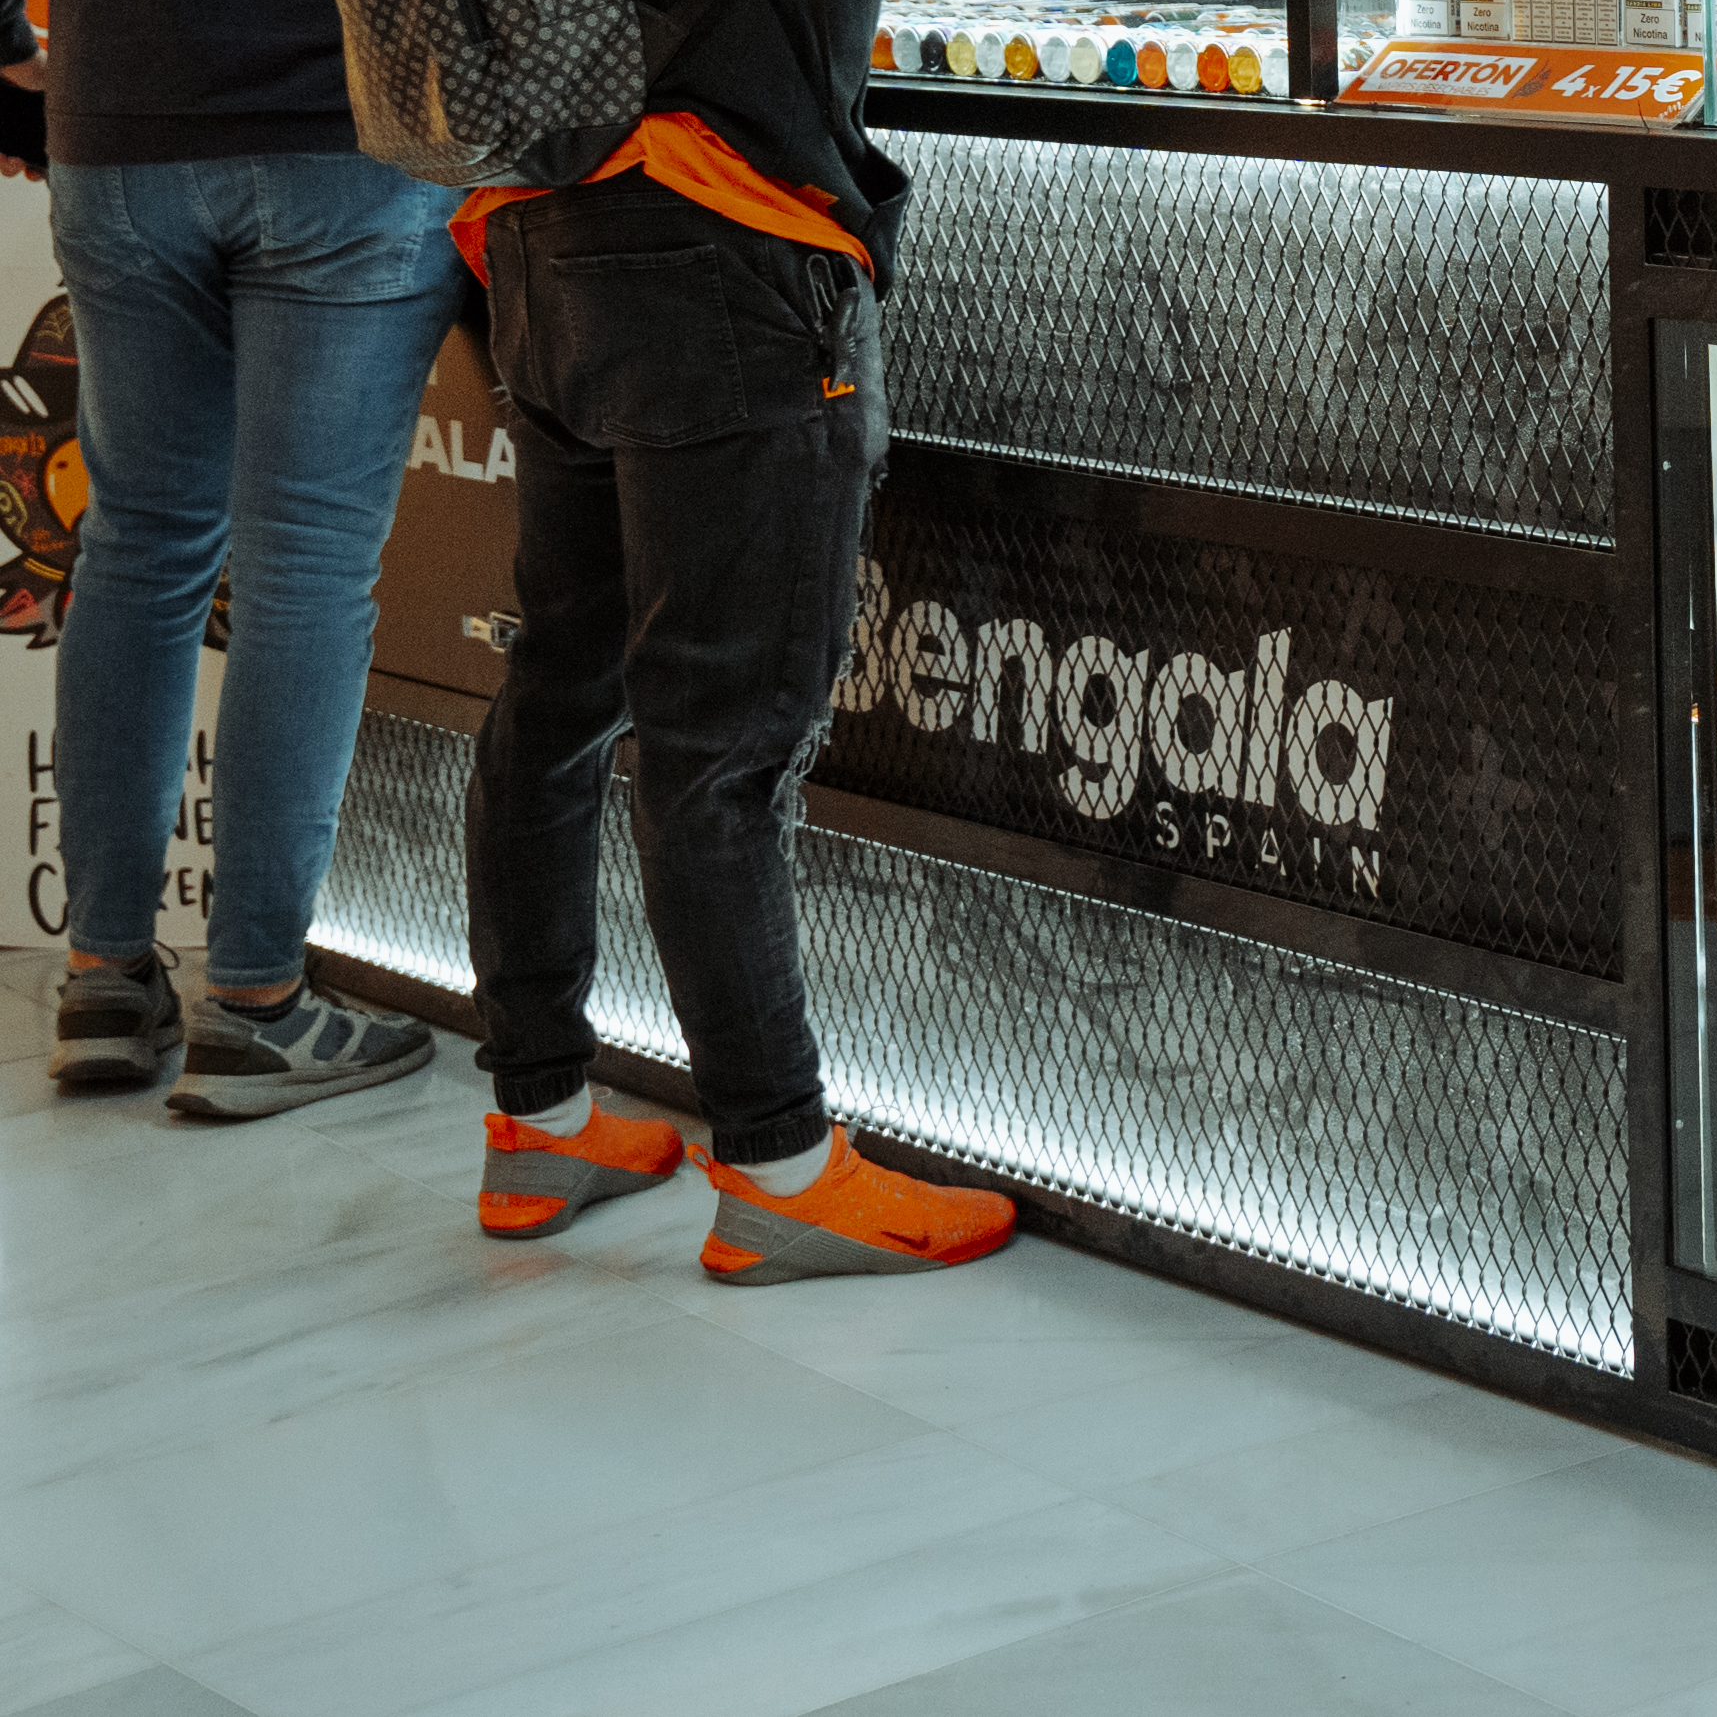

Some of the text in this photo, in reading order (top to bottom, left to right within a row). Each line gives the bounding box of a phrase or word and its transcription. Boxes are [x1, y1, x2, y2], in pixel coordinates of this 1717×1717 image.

[1416, 4, 1434, 14] Zero
[1473, 7, 1491, 17] Zero
[1411, 18, 1441, 29] Nicotina
[1640, 13, 1660, 24] Zero
[1467, 21, 1499, 32] Nicotina
[1633, 28, 1668, 39] Nicotina
[1379, 58, 1523, 86] OFERTÓN
[1155, 801, 1380, 899] SPAIN
